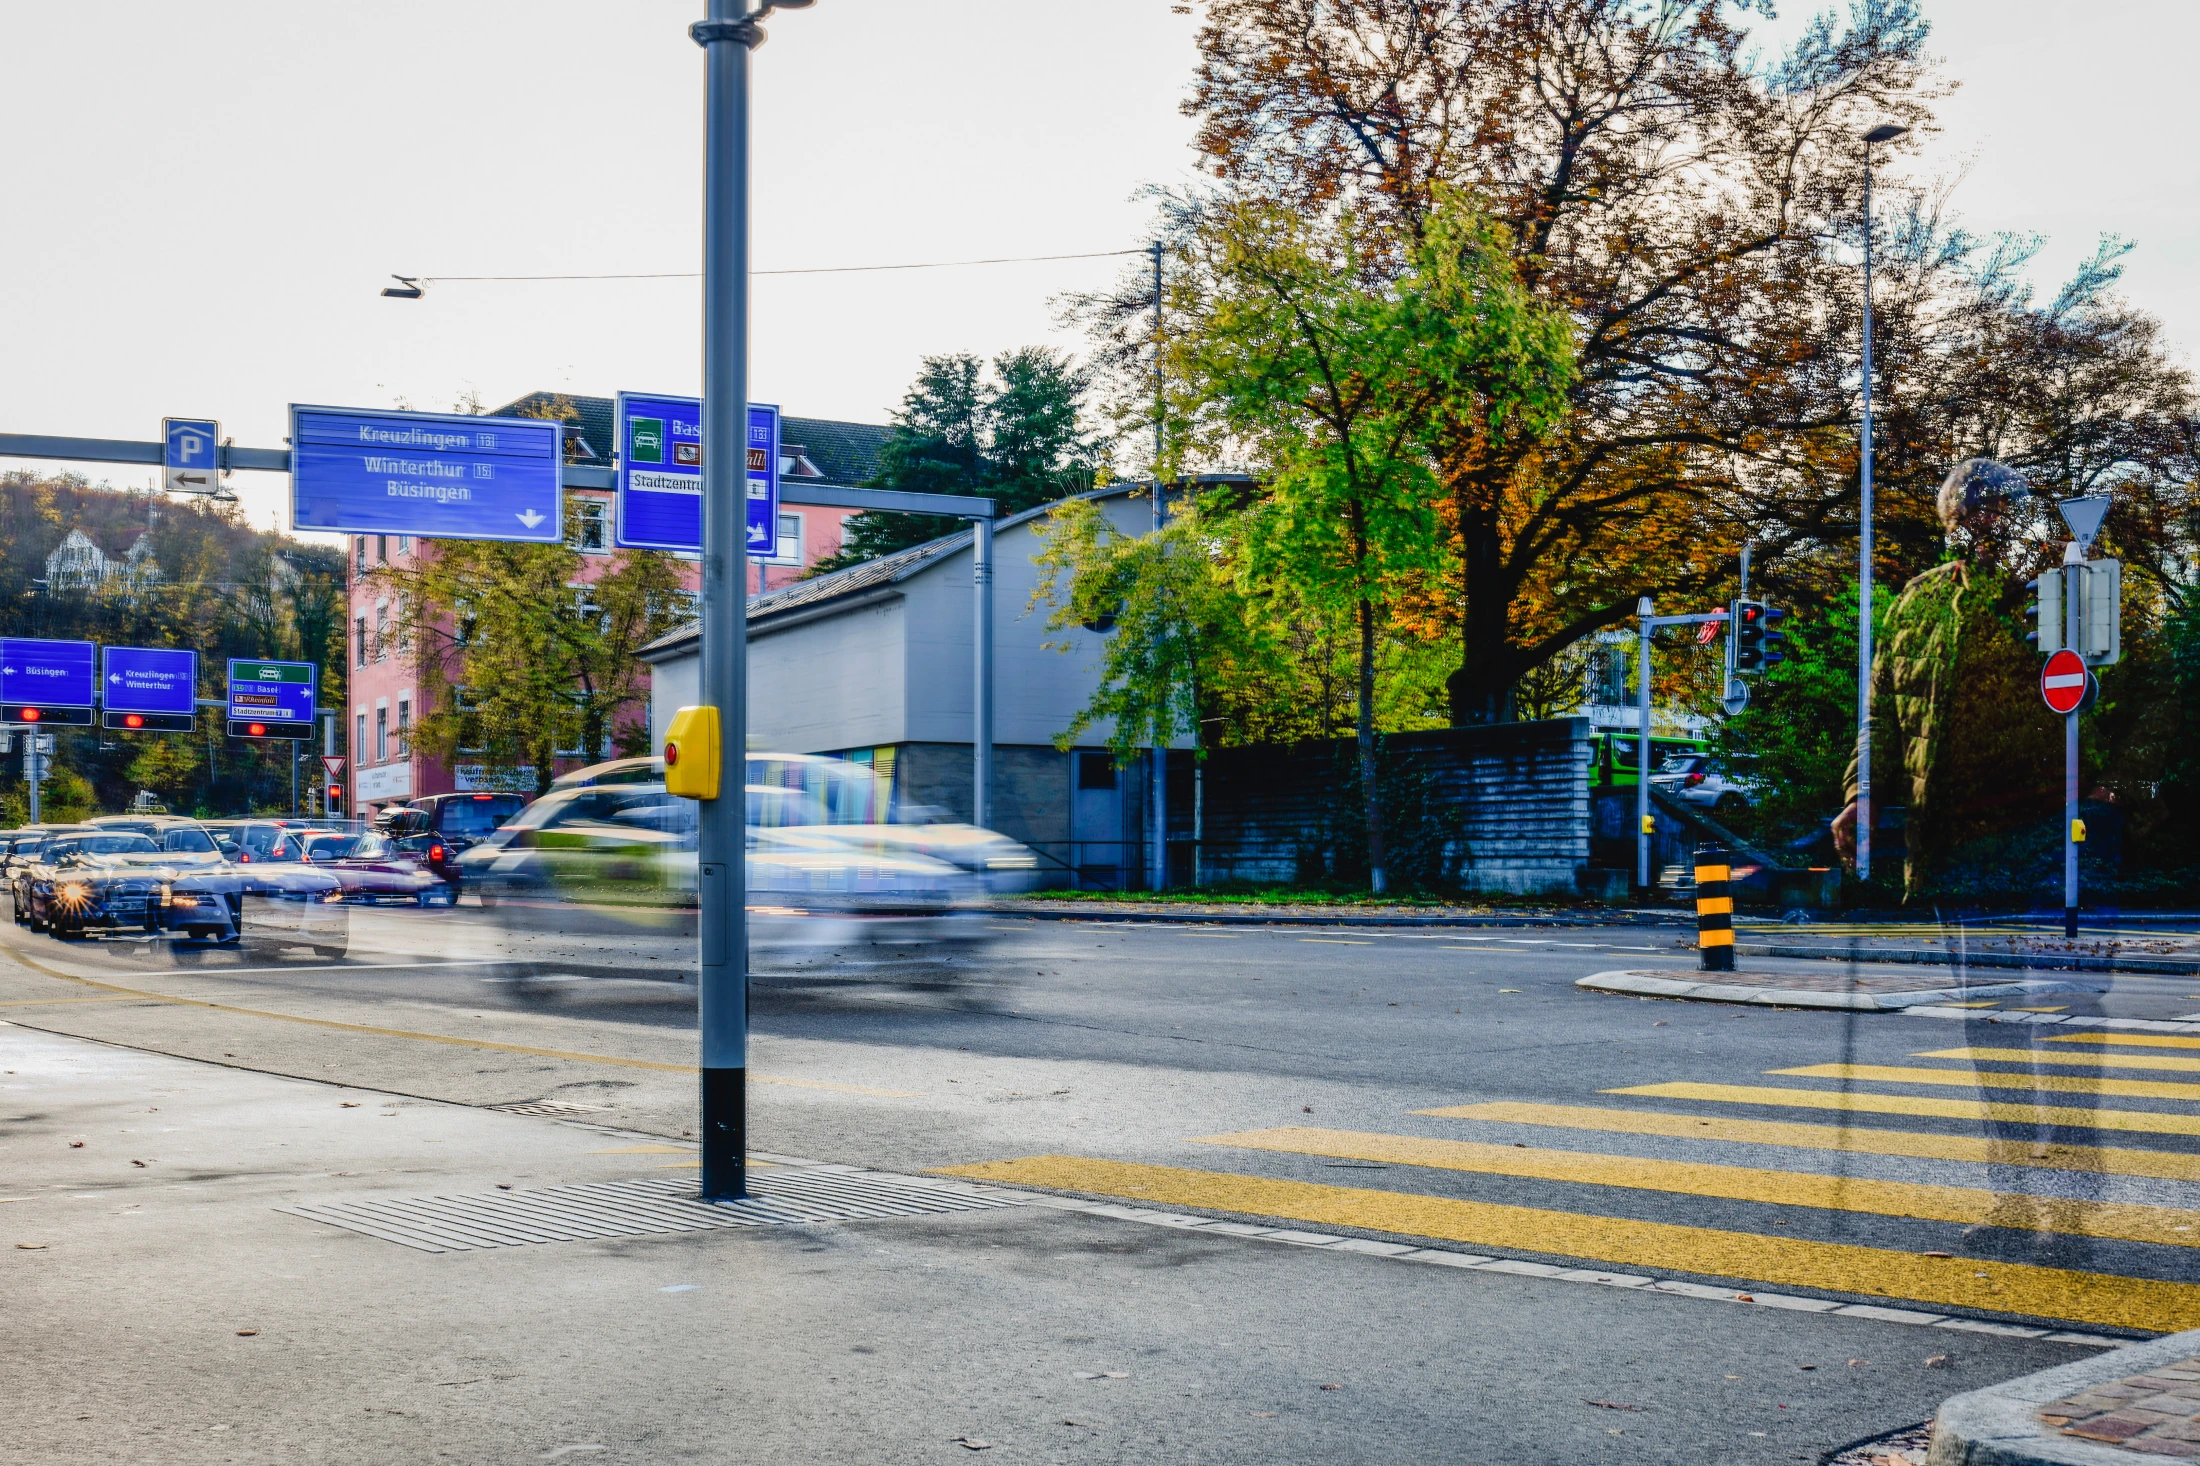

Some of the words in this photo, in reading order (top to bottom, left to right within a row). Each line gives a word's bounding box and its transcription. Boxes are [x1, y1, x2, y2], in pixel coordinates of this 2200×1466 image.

[673, 420, 704, 437] Bas
[359, 425, 469, 450] Kreuzlingen
[479, 435, 494, 447] 13
[181, 435, 203, 463] P
[364, 457, 466, 478] Winterthur
[387, 480, 472, 502] Büsingen
[634, 474, 704, 491] Stadtzentru
[26, 666, 68, 677] Büsingen
[126, 669, 176, 681] Kreuzlingen
[126, 680, 173, 690] Winterthur
[257, 685, 280, 694] Basel
[233, 707, 275, 717] Stadtzentrum
